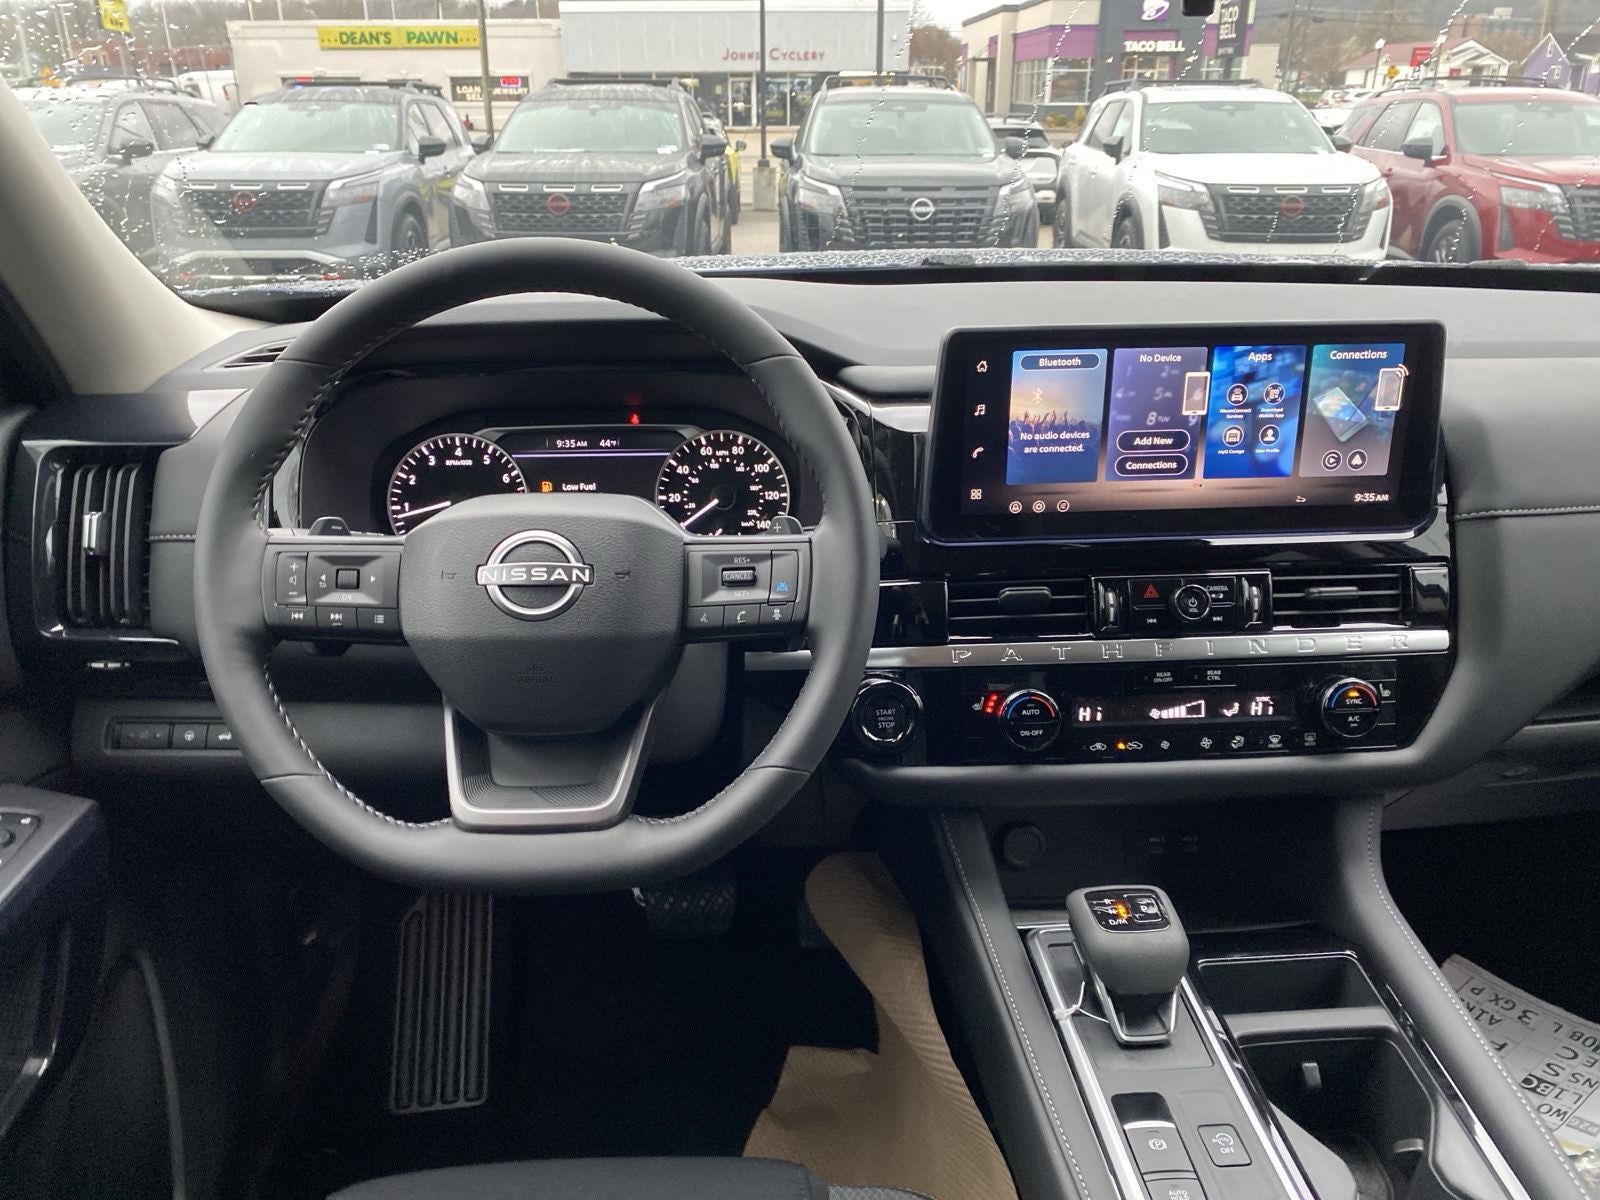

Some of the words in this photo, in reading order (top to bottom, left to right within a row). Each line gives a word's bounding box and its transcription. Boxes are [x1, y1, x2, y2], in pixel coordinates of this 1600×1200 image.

[1220, 6, 1239, 22] TACO
[1219, 23, 1237, 40] BELL
[338, 31, 392, 45] DEAN'S
[406, 31, 460, 44] PAWN
[1124, 40, 1155, 52] TACO
[1156, 40, 1185, 52] BELL
[1139, 354, 1152, 362] No
[1154, 353, 1182, 362] Device
[1248, 352, 1273, 362] Apps
[1330, 350, 1387, 360] Connections
[1039, 356, 1081, 367] Bluetooth
[1020, 432, 1032, 440] No
[1034, 431, 1058, 440] audio
[1059, 431, 1090, 440] devices
[556, 439, 575, 448] 9:35
[1133, 437, 1152, 445] Add
[1153, 437, 1173, 445] New
[454, 447, 463, 457] 4
[700, 446, 712, 456] 60
[732, 446, 744, 455] 80
[1039, 444, 1085, 453] connected.
[428, 455, 436, 465] 3
[483, 455, 491, 465] 5
[676, 465, 689, 474] 40
[754, 463, 770, 473] 100
[1125, 461, 1177, 470] Connections
[409, 475, 416, 485] 2
[502, 473, 510, 483] 6
[562, 483, 578, 491] Low
[580, 482, 596, 490] Fuel
[668, 493, 681, 502] 20
[764, 491, 779, 500] 120
[1354, 493, 1375, 502] 9:35
[404, 502, 409, 512] 1
[756, 520, 771, 529] 140
[482, 567, 590, 583] NISSAN
[951, 634, 1410, 663] PATHFINDER
[876, 708, 896, 716] START
[1250, 699, 1274, 716] Hi
[1078, 706, 1103, 721] Hi
[1020, 729, 1043, 737] ON-OFF
